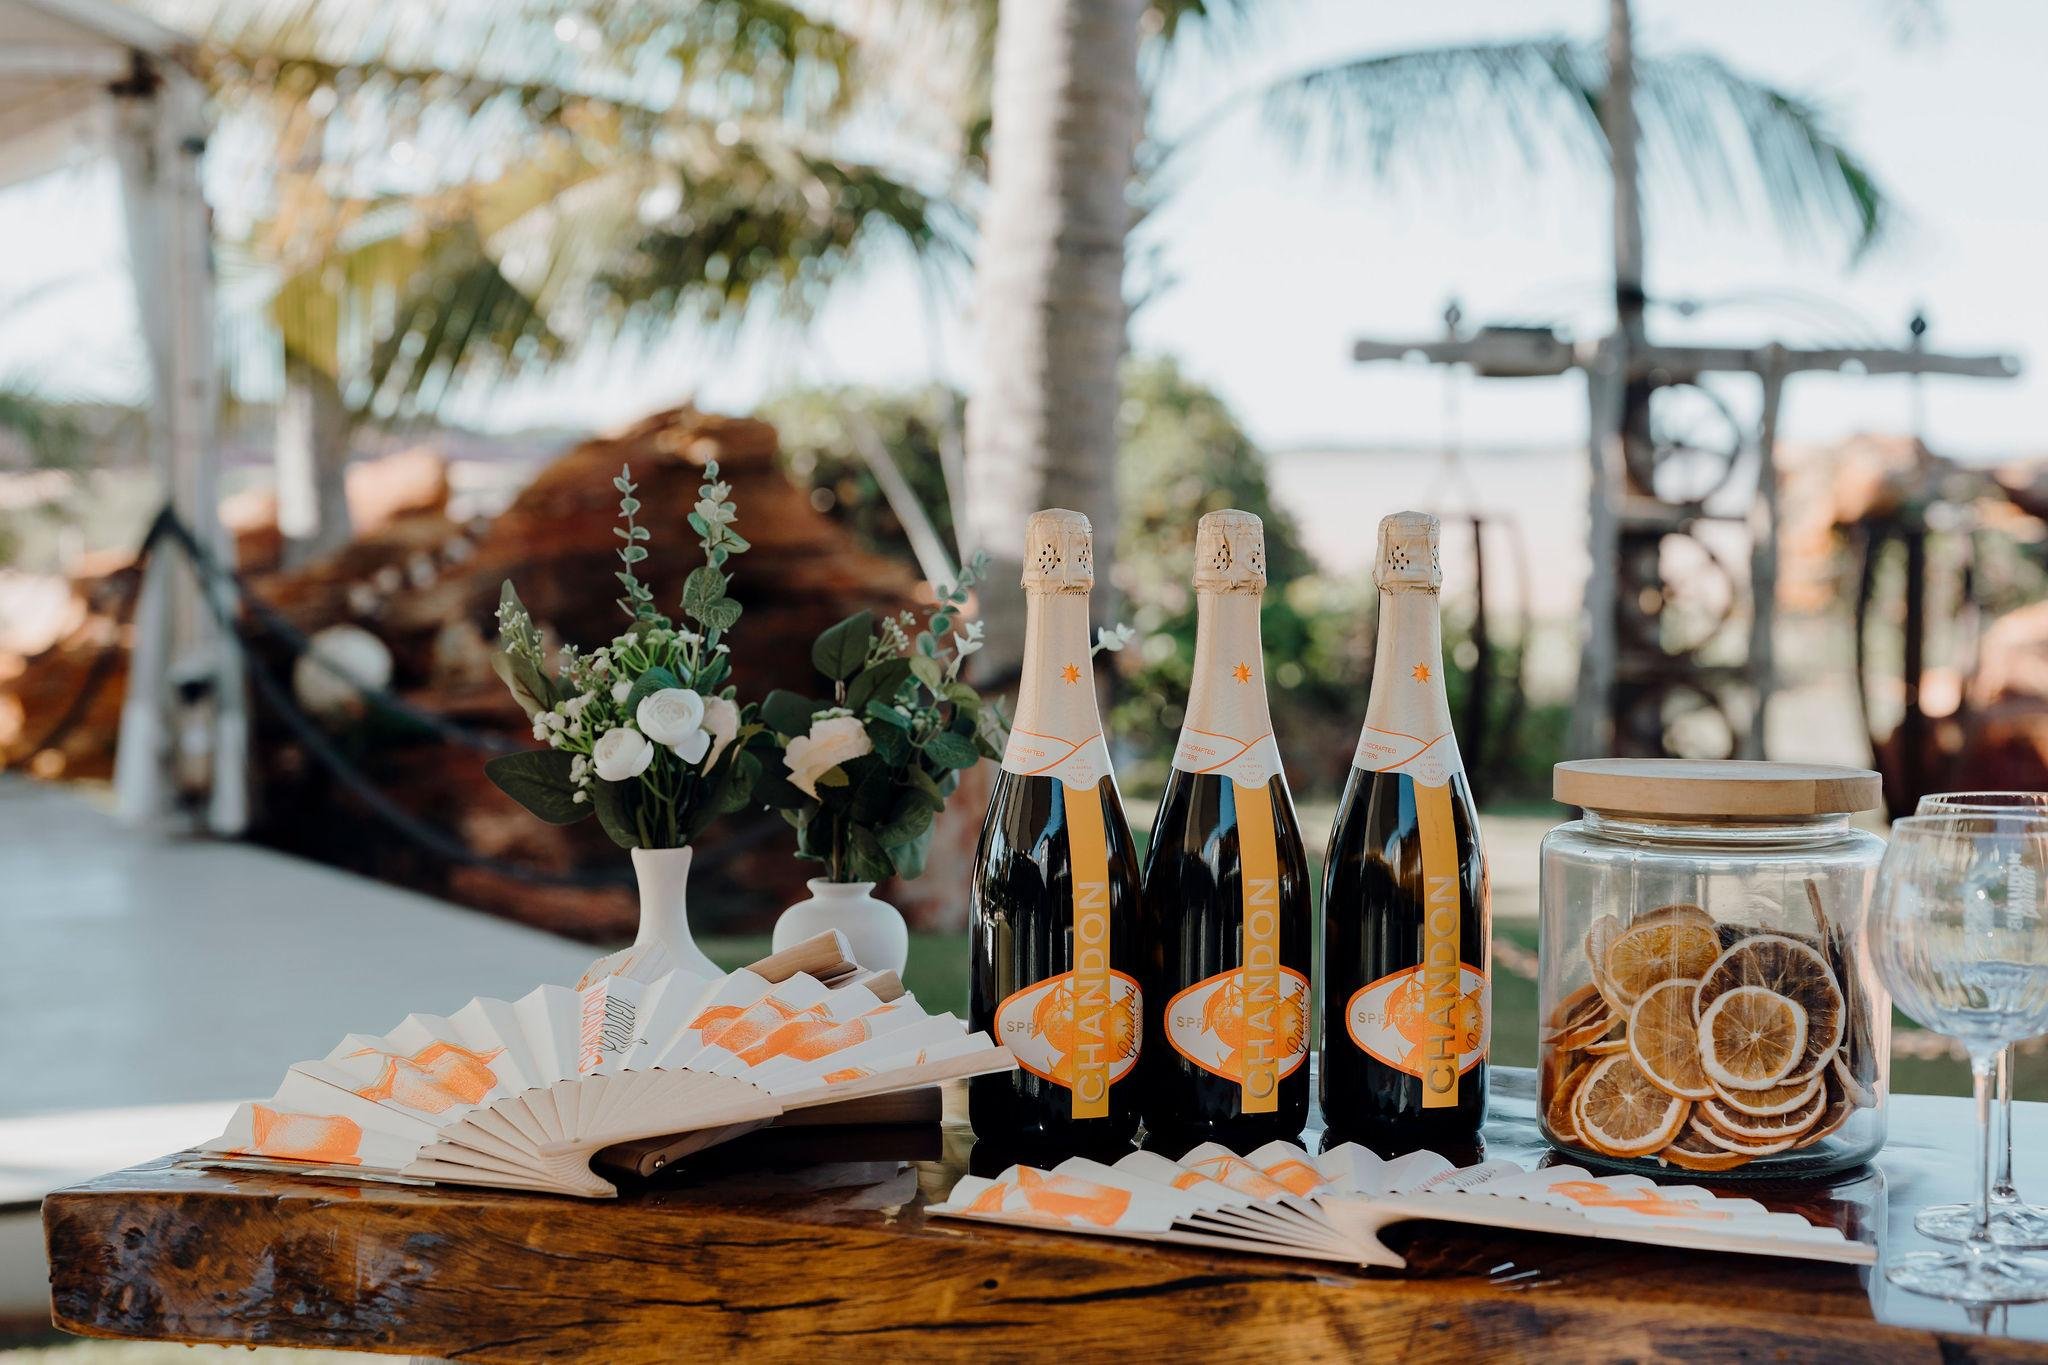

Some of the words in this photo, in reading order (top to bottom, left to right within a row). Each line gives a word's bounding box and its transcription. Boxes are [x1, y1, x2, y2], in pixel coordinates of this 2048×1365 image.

[578, 985, 606, 1073] CHANDON
[1077, 881, 1107, 1104] CHANDON
[1247, 877, 1276, 1099] CHANDON
[1428, 874, 1458, 1094] CHANDON
